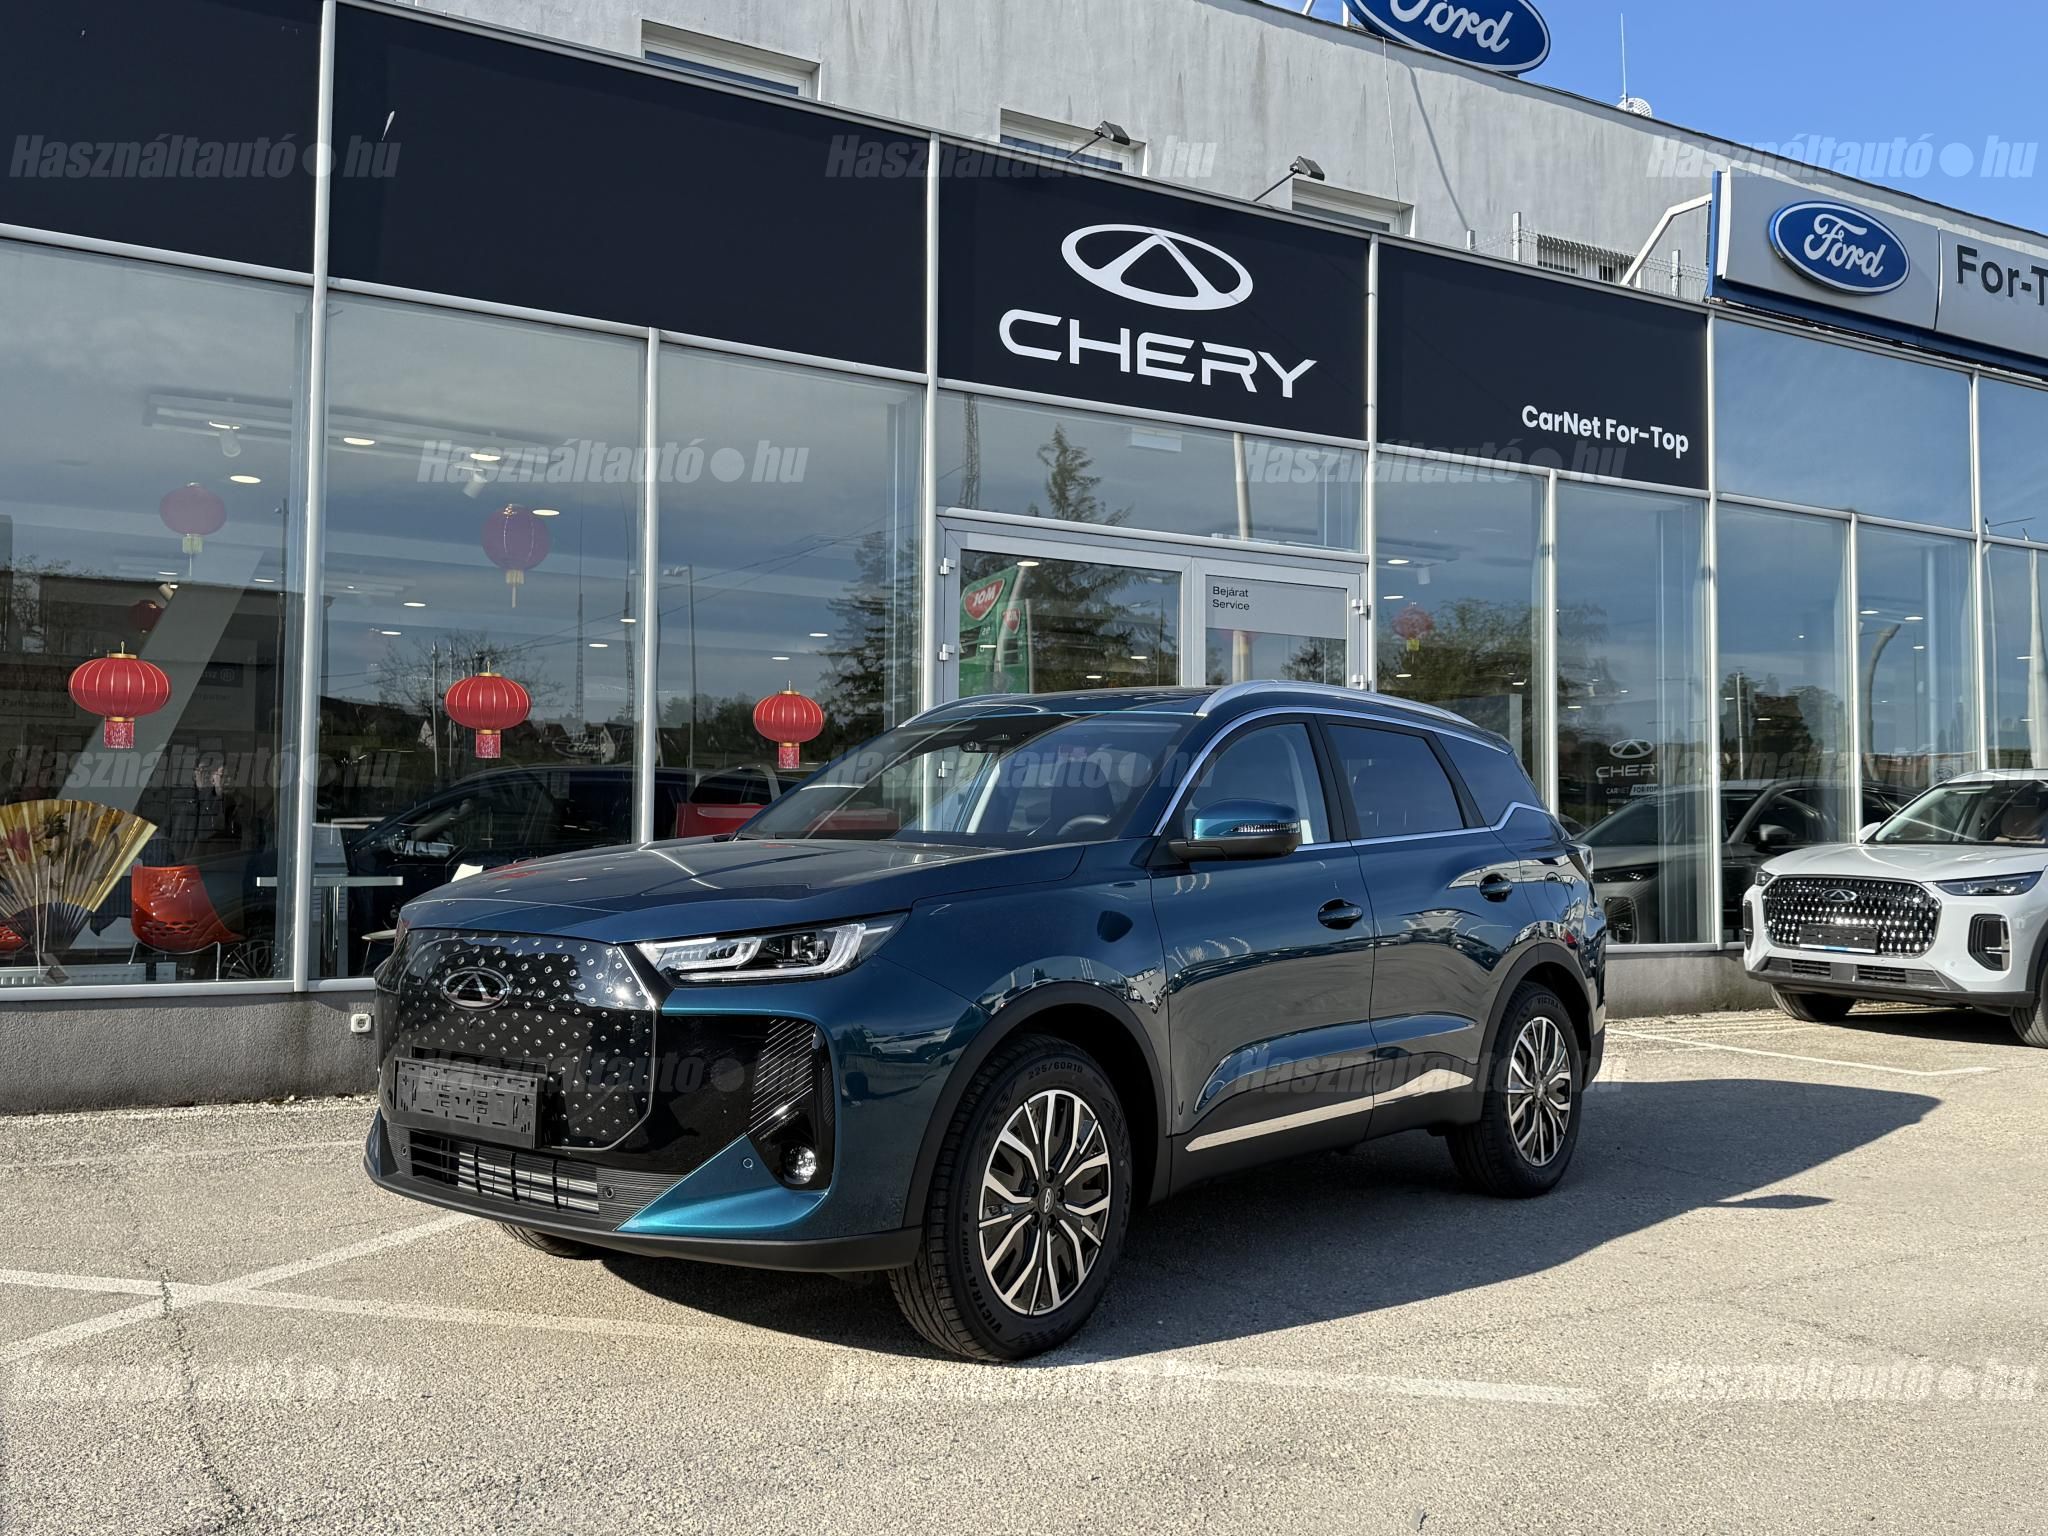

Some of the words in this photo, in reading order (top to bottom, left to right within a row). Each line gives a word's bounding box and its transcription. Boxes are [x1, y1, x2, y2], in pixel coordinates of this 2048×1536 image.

[1804, 214, 1886, 277] Ford
[999, 309, 1317, 398] CHERY
[1522, 405, 1600, 439] CarNet
[1606, 418, 1689, 459] For-Top
[1212, 586, 1249, 598] Bejárat
[1212, 599, 1250, 610] Service
[967, 1275, 1001, 1334] VICTRA
